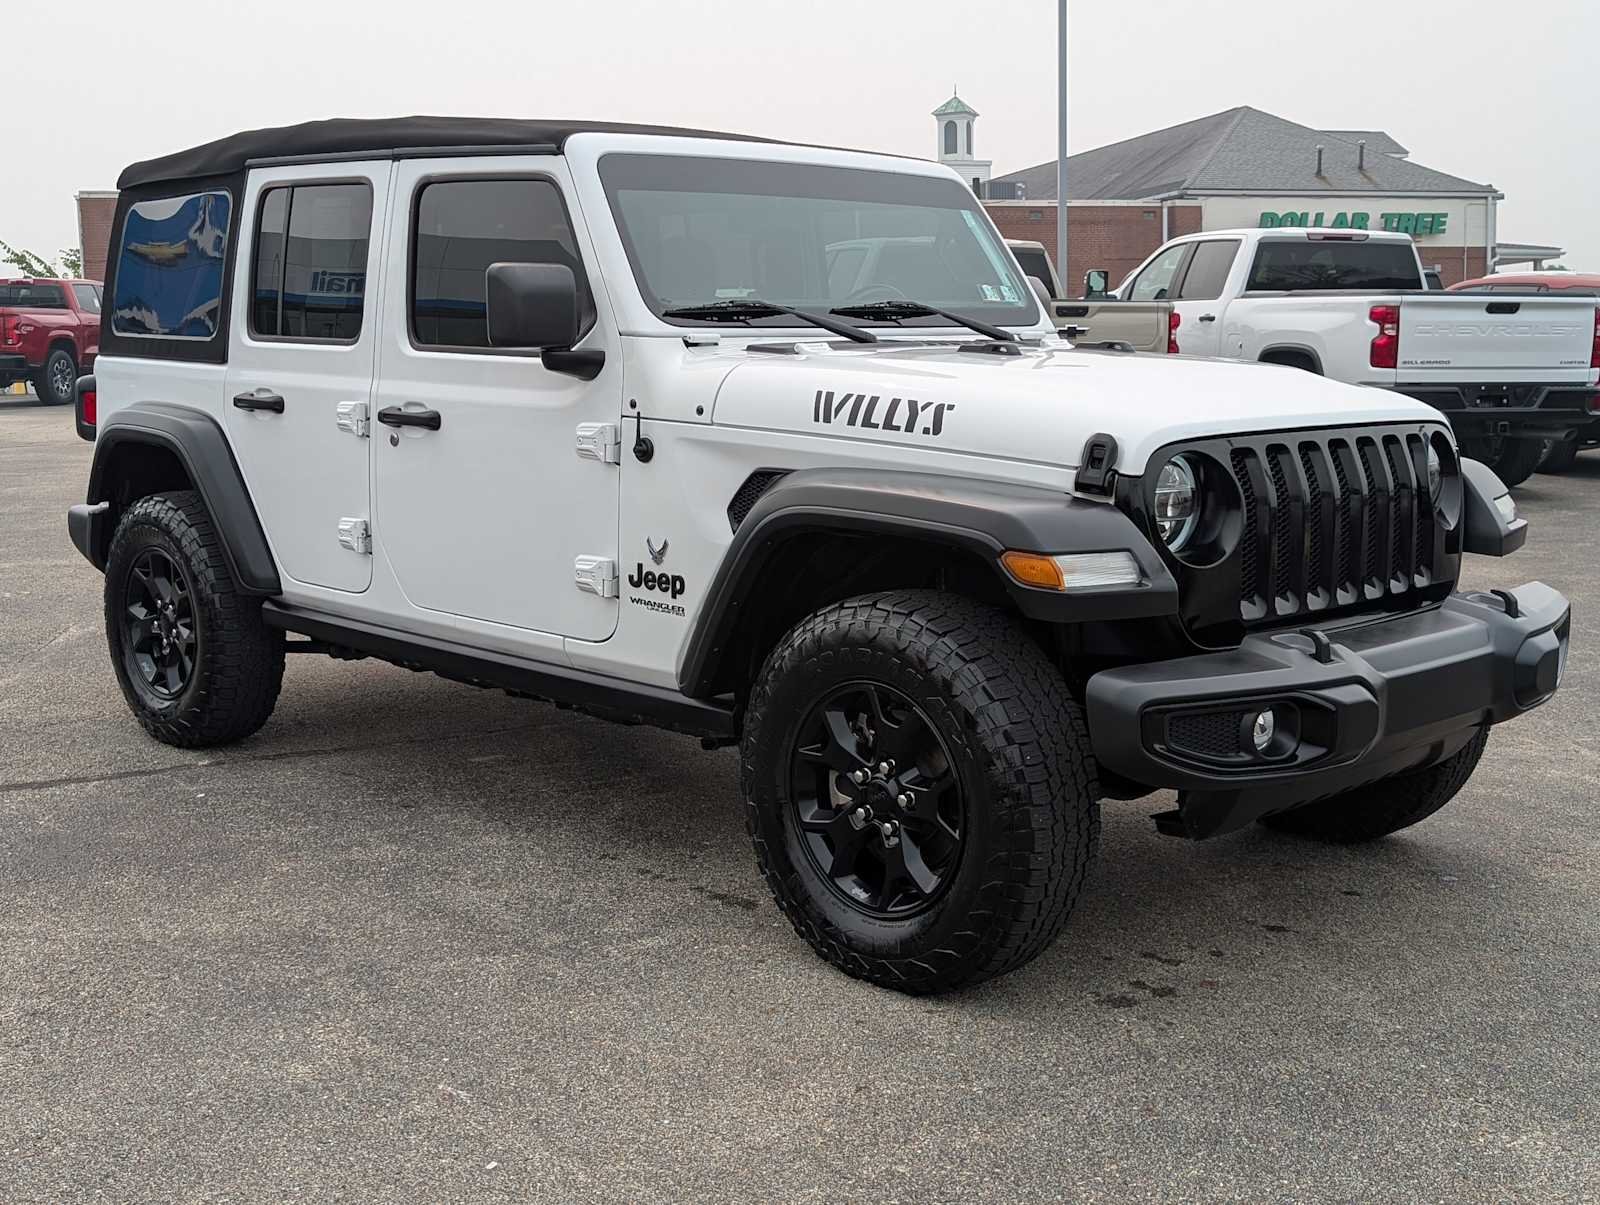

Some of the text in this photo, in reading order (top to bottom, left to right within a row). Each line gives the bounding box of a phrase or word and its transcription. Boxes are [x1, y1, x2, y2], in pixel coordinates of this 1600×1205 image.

[1258, 211, 1448, 235] DOLLAR TREE
[1413, 324, 1584, 337] CHEVROLET
[813, 390, 955, 436] WILLYS
[628, 562, 685, 600] Jeep
[629, 596, 685, 613] WRANGLER
